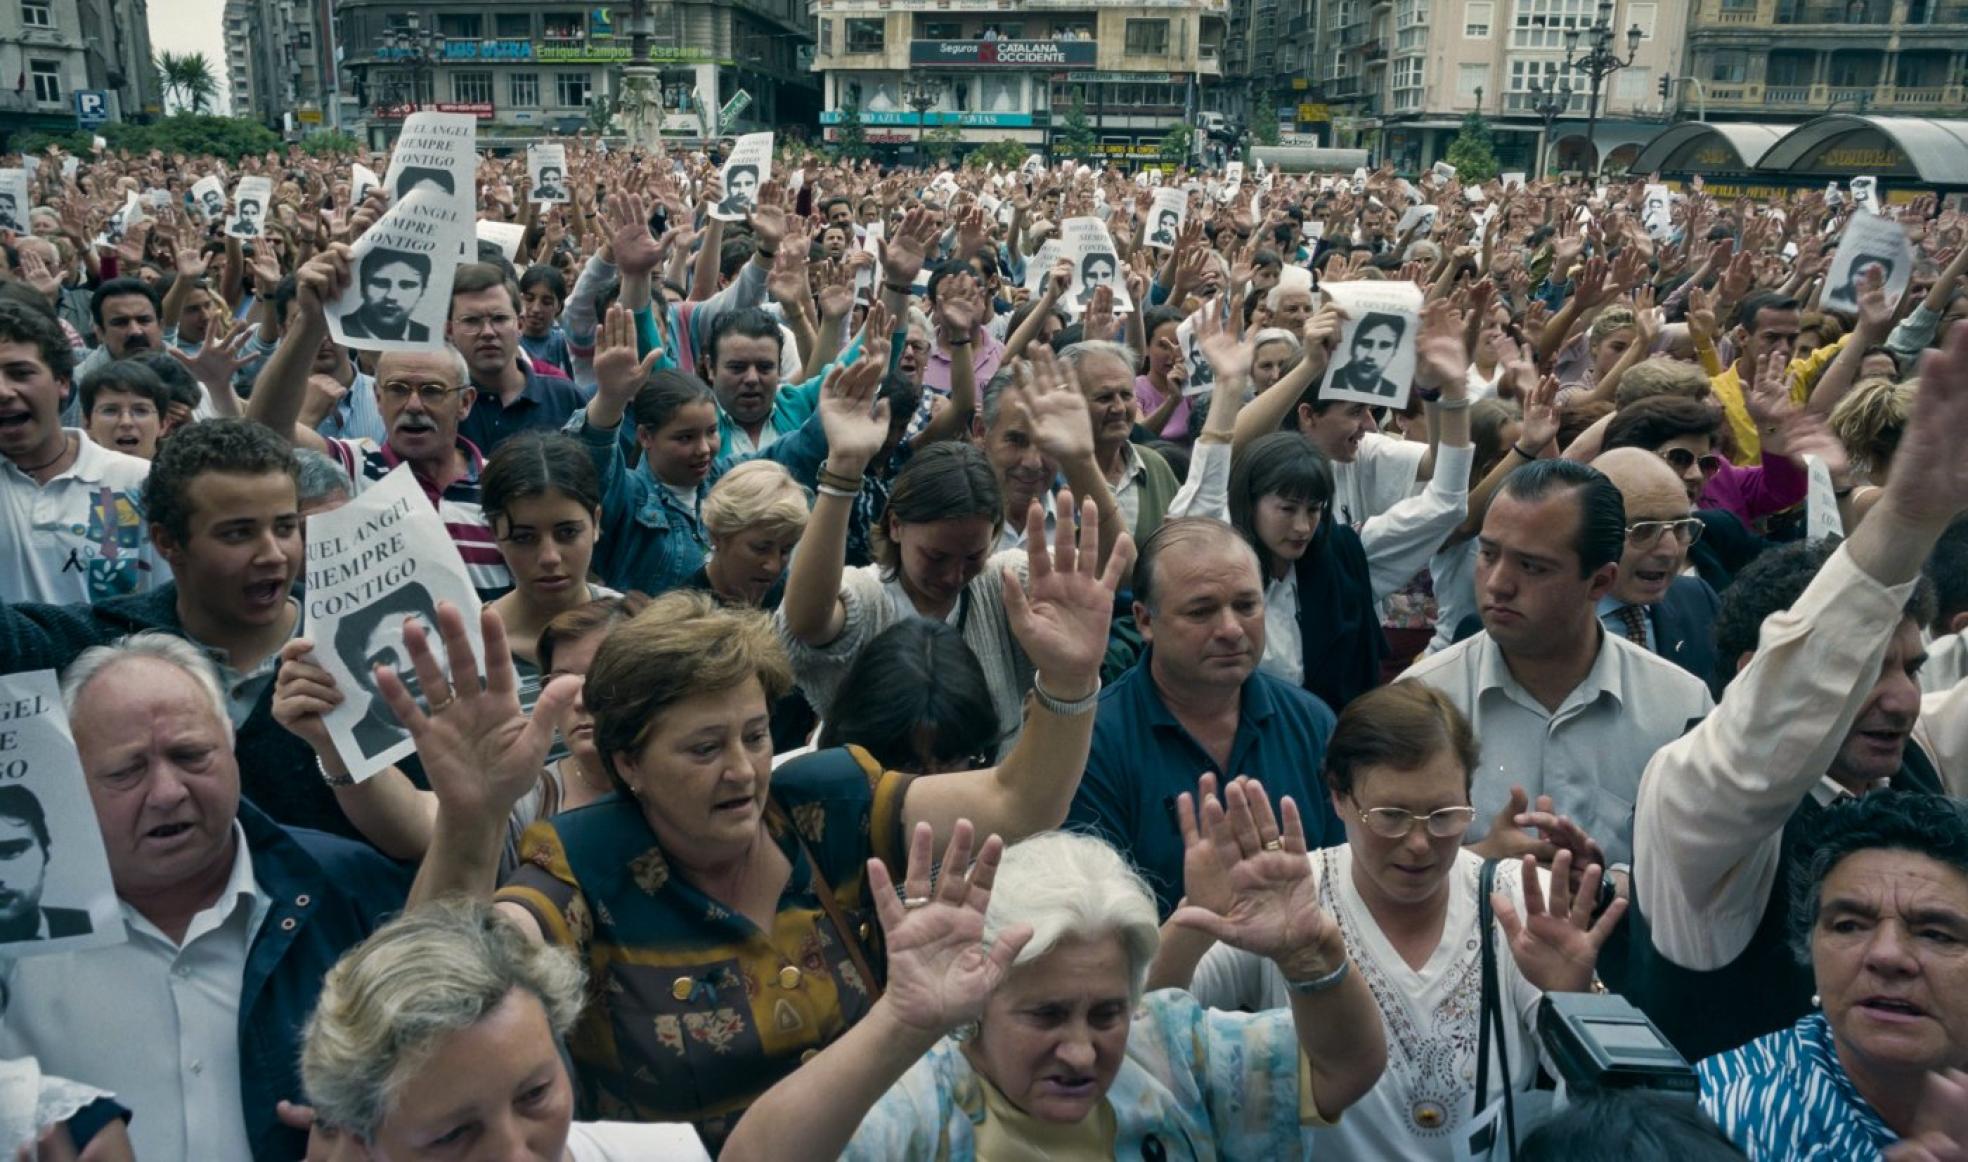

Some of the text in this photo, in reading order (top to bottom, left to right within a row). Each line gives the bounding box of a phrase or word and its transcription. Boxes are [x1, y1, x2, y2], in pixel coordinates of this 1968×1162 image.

[940, 43, 1058, 55] Seguros CATALANA
[997, 53, 1065, 62] OCCIDENTE
[353, 496, 414, 546] ANGEL
[311, 557, 417, 620] CONTIGO
